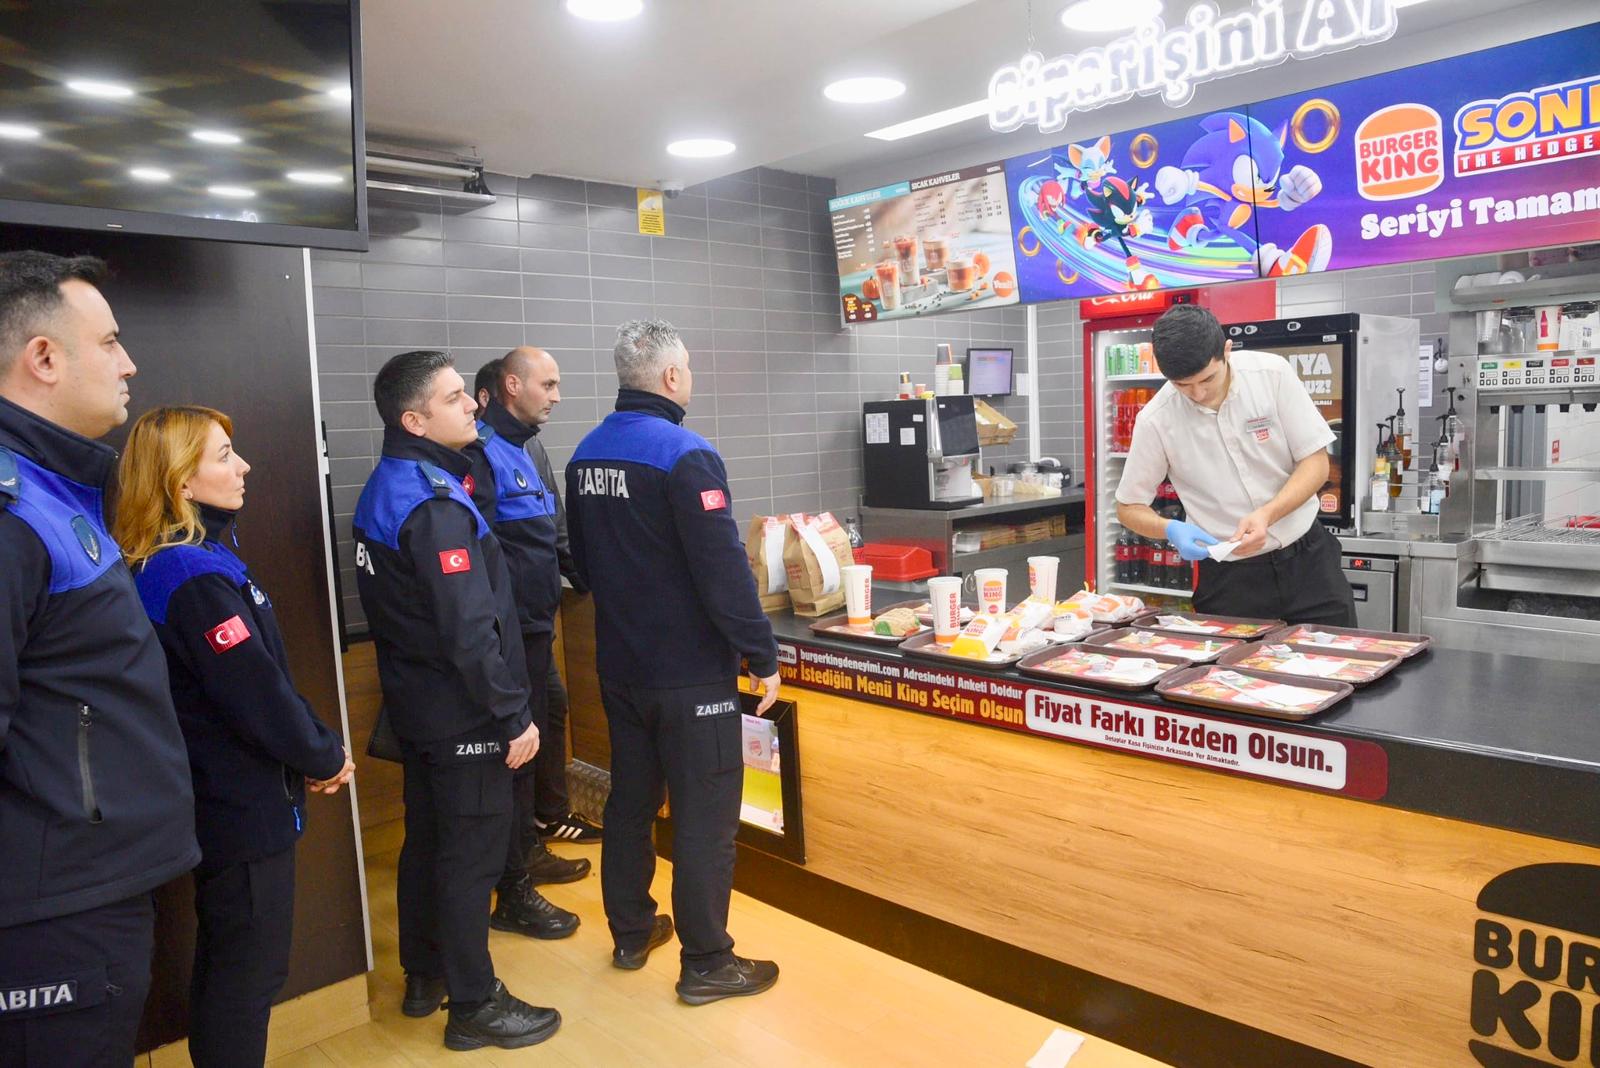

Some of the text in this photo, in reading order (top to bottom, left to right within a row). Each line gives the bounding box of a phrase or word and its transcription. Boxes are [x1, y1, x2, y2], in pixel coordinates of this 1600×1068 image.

[1360, 129, 1438, 159] BURGER
[1460, 135, 1594, 171] THE HEDGE
[1361, 148, 1439, 184] KING
[1360, 185, 1600, 240] Seriyi Tamam
[577, 466, 630, 499] ZABITA
[800, 649, 900, 678] burgerkingdeneyimi.com
[903, 668, 955, 688] Adresindeki
[957, 677, 987, 693] Anketi
[990, 682, 1023, 700] Doldur
[696, 700, 736, 717] ZABITA
[800, 661, 852, 690] İstediğin
[857, 674, 892, 698] Menü
[897, 683, 928, 707] King
[932, 690, 974, 715] Seçim
[980, 698, 1024, 725] Olsun
[456, 742, 501, 756] ZABITA
[1033, 694, 1333, 773] Fiyat Farkı Bizden Olsun.
[1128, 738, 1141, 748] Kasa
[1165, 746, 1194, 758] Arkasında
[1195, 751, 1205, 760] Yer
[1474, 918, 1600, 997] BUR
[1470, 969, 1600, 1068] KI
